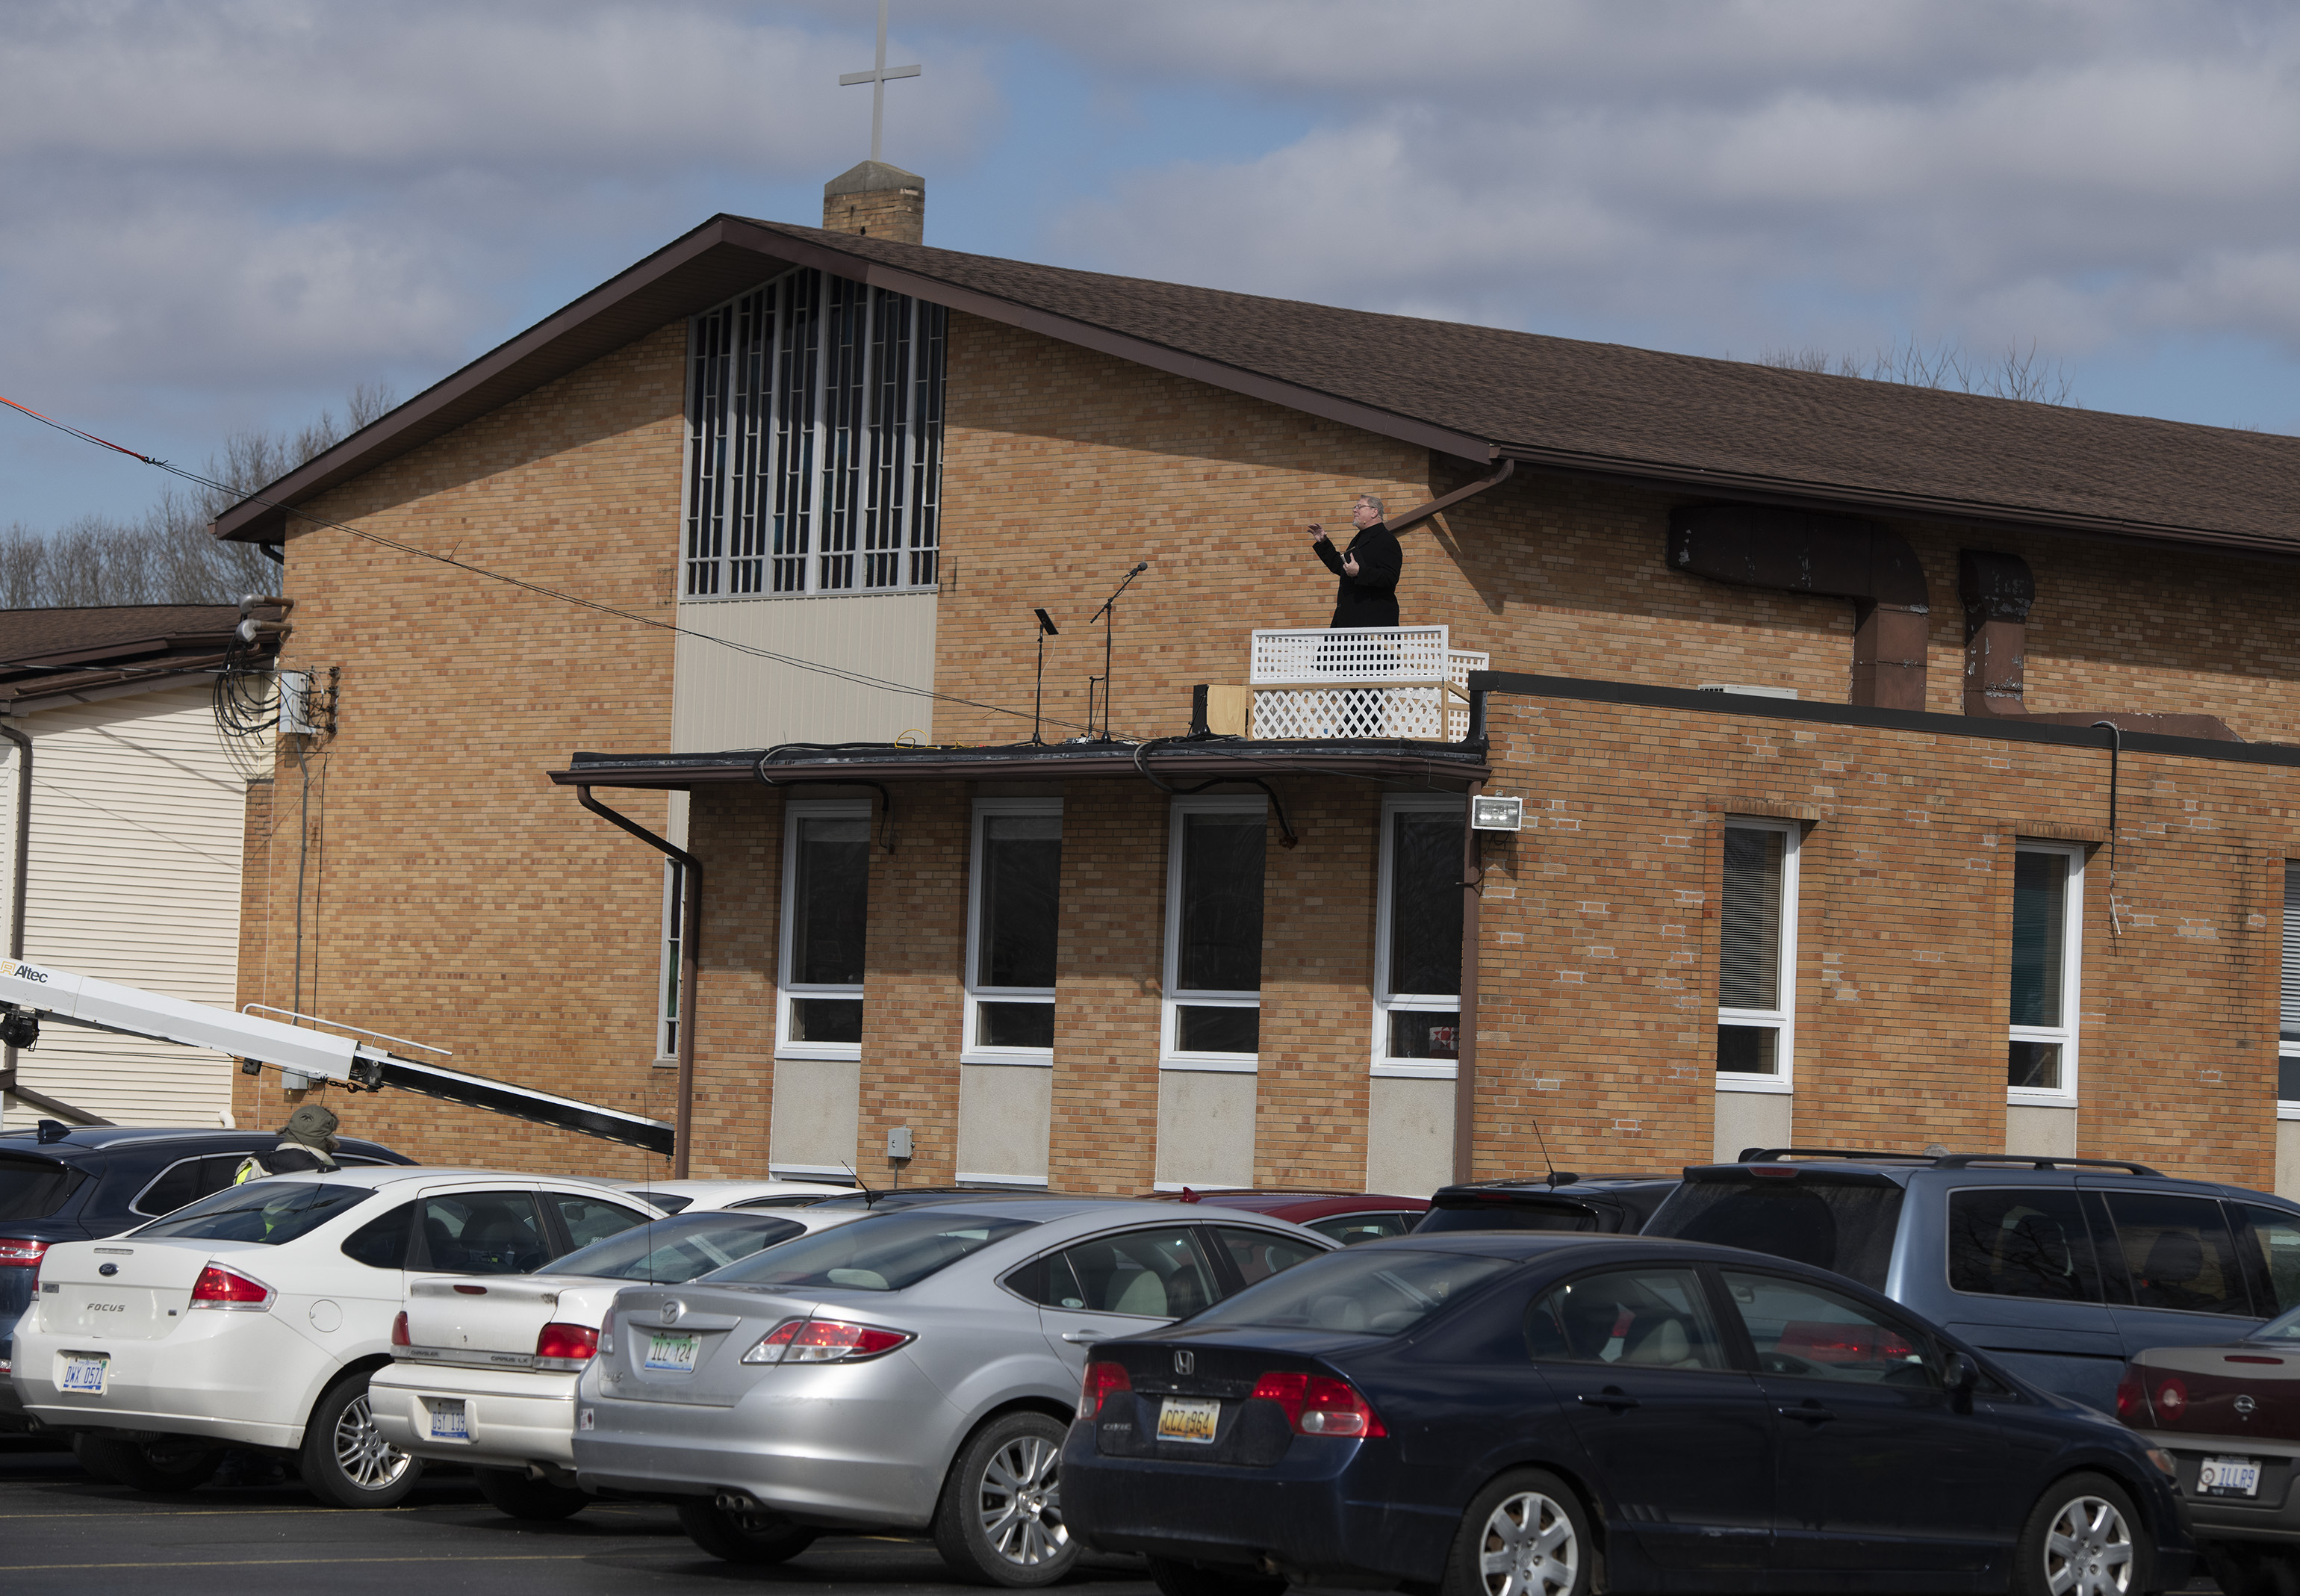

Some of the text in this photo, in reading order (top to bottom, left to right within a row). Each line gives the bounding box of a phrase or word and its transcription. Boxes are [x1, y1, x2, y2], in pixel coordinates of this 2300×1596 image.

[14, 965, 48, 983] Altec
[87, 1303, 125, 1312] FOCUS
[651, 1342, 692, 1362] 1LZ Y24
[65, 1366, 104, 1384] DWX 0571
[1165, 1409, 1210, 1433] CCZ 964
